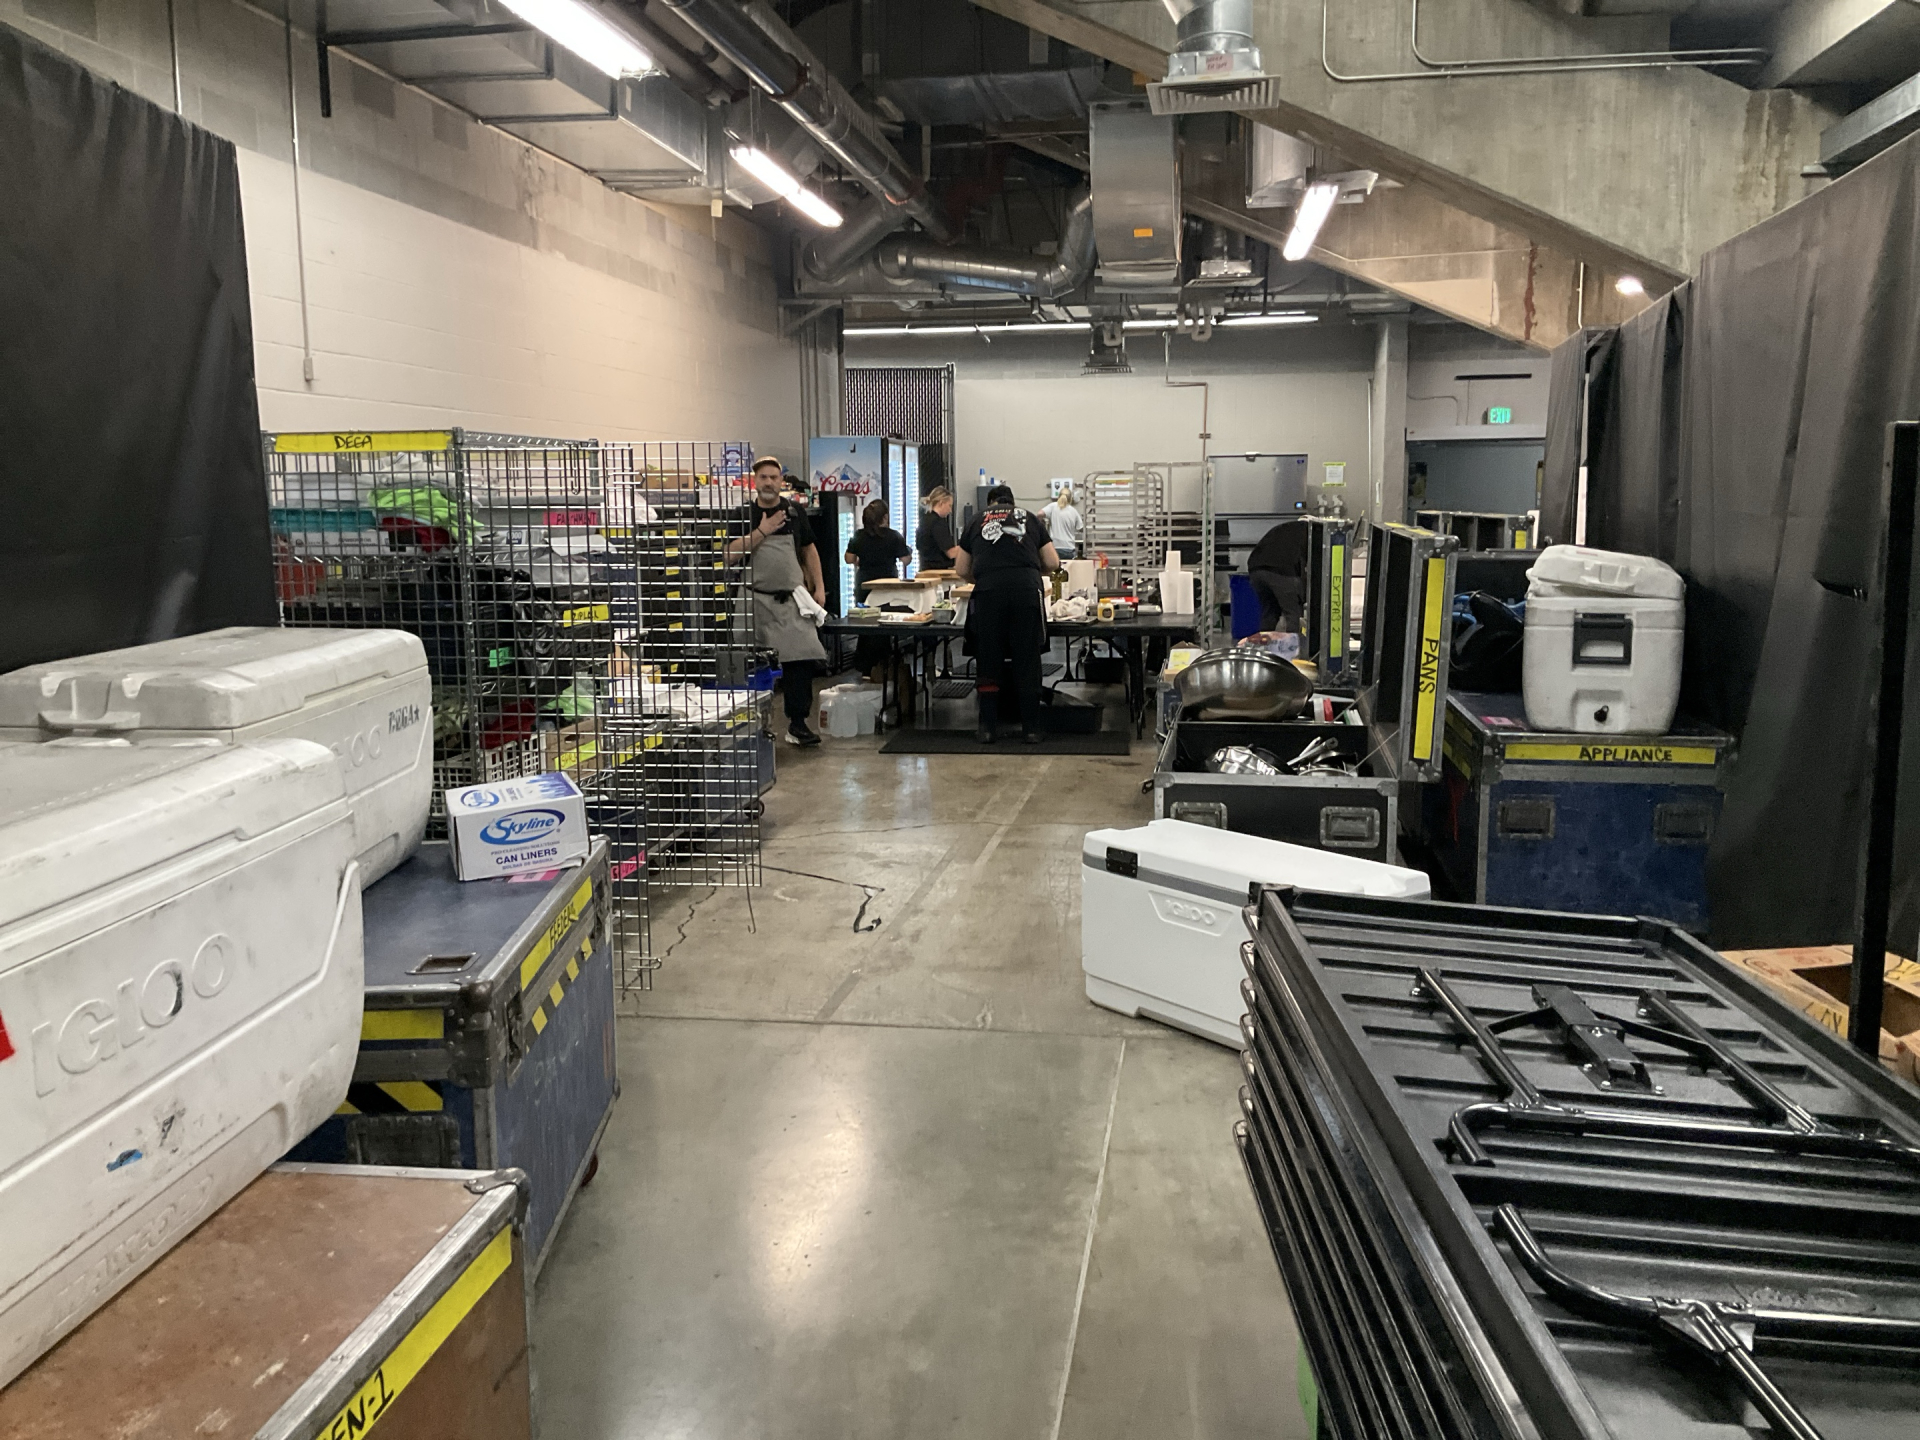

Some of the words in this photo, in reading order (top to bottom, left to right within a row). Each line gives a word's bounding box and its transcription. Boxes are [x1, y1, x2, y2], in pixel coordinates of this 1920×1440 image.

[1490, 408, 1511, 423] EXIT
[820, 475, 871, 495] Coors
[1331, 575, 1342, 622] EXTRAS
[1419, 637, 1440, 694] PANS
[331, 724, 382, 774] LOO
[1579, 746, 1673, 762] APPLIANCE
[495, 816, 555, 840] Skyline
[496, 854, 518, 865] CAN
[520, 847, 557, 860] LINERS
[1166, 899, 1217, 925] IGLOO
[31, 932, 236, 1099] IGLOO
